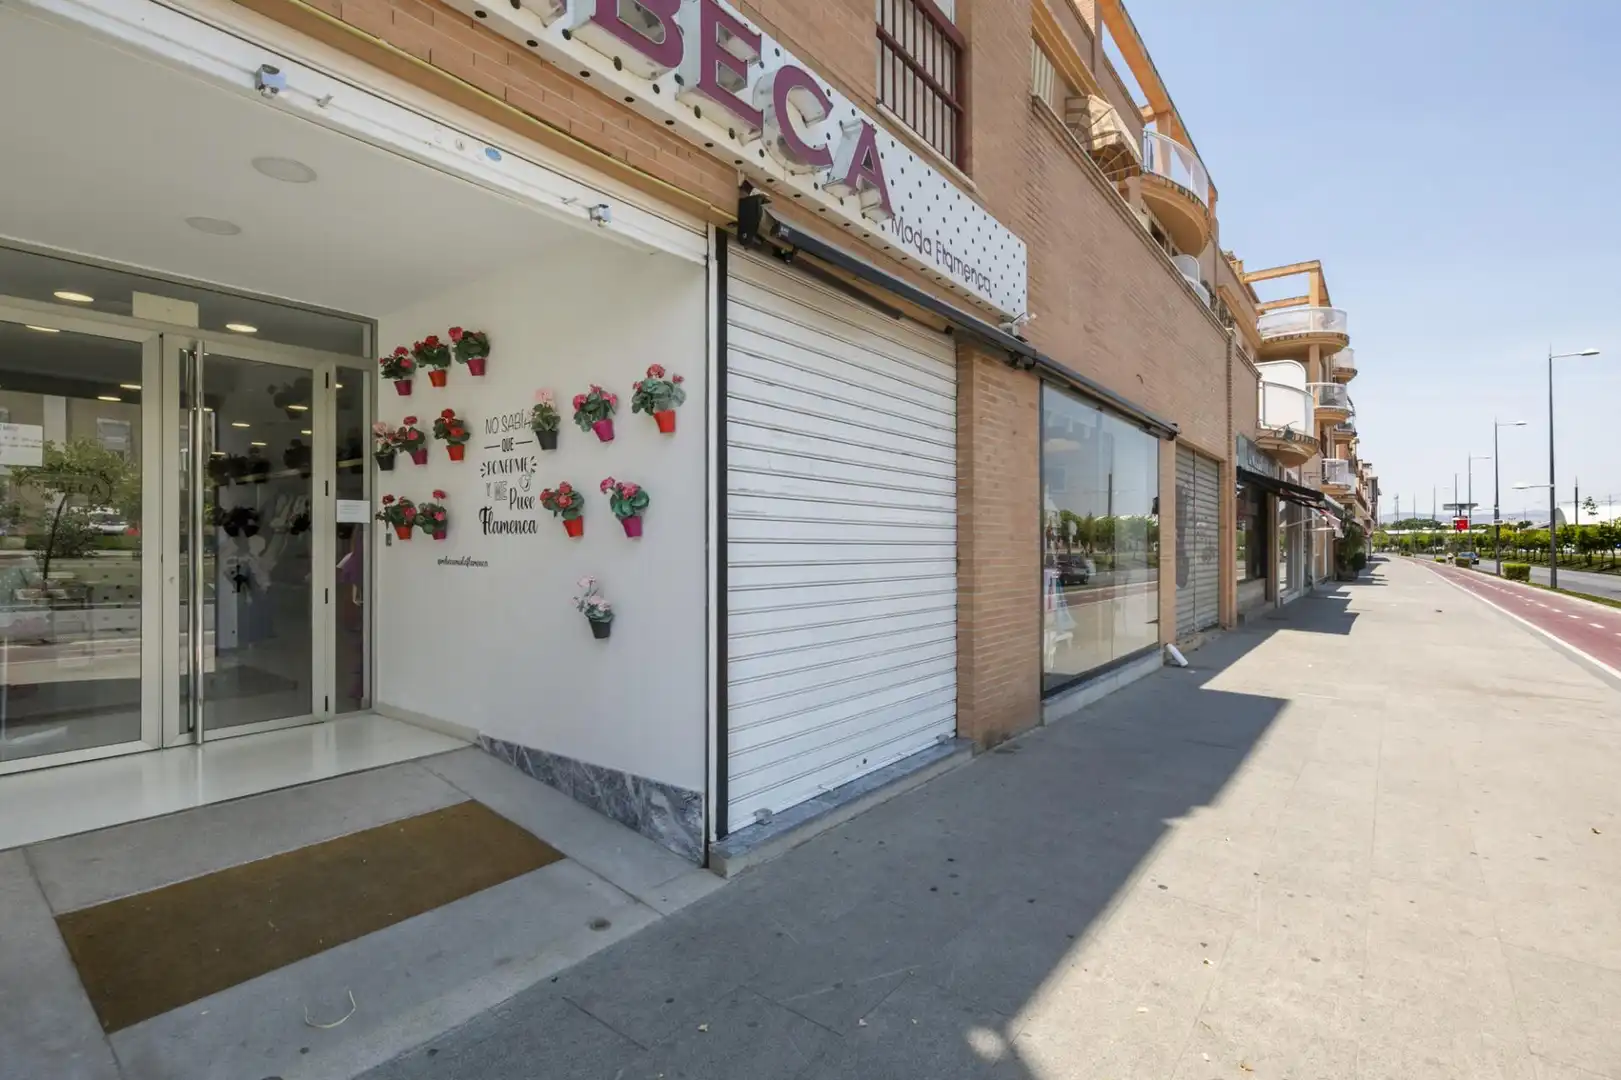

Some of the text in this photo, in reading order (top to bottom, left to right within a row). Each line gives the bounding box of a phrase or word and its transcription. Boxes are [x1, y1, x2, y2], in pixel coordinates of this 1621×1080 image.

[560, 0, 895, 218] BECA
[891, 215, 992, 296] Moda Flamenca
[485, 409, 532, 435] NO SABÍA
[502, 437, 514, 452] QUE
[487, 456, 529, 475] PONERME
[509, 487, 535, 510] Puse
[479, 506, 539, 535] Flamenca
